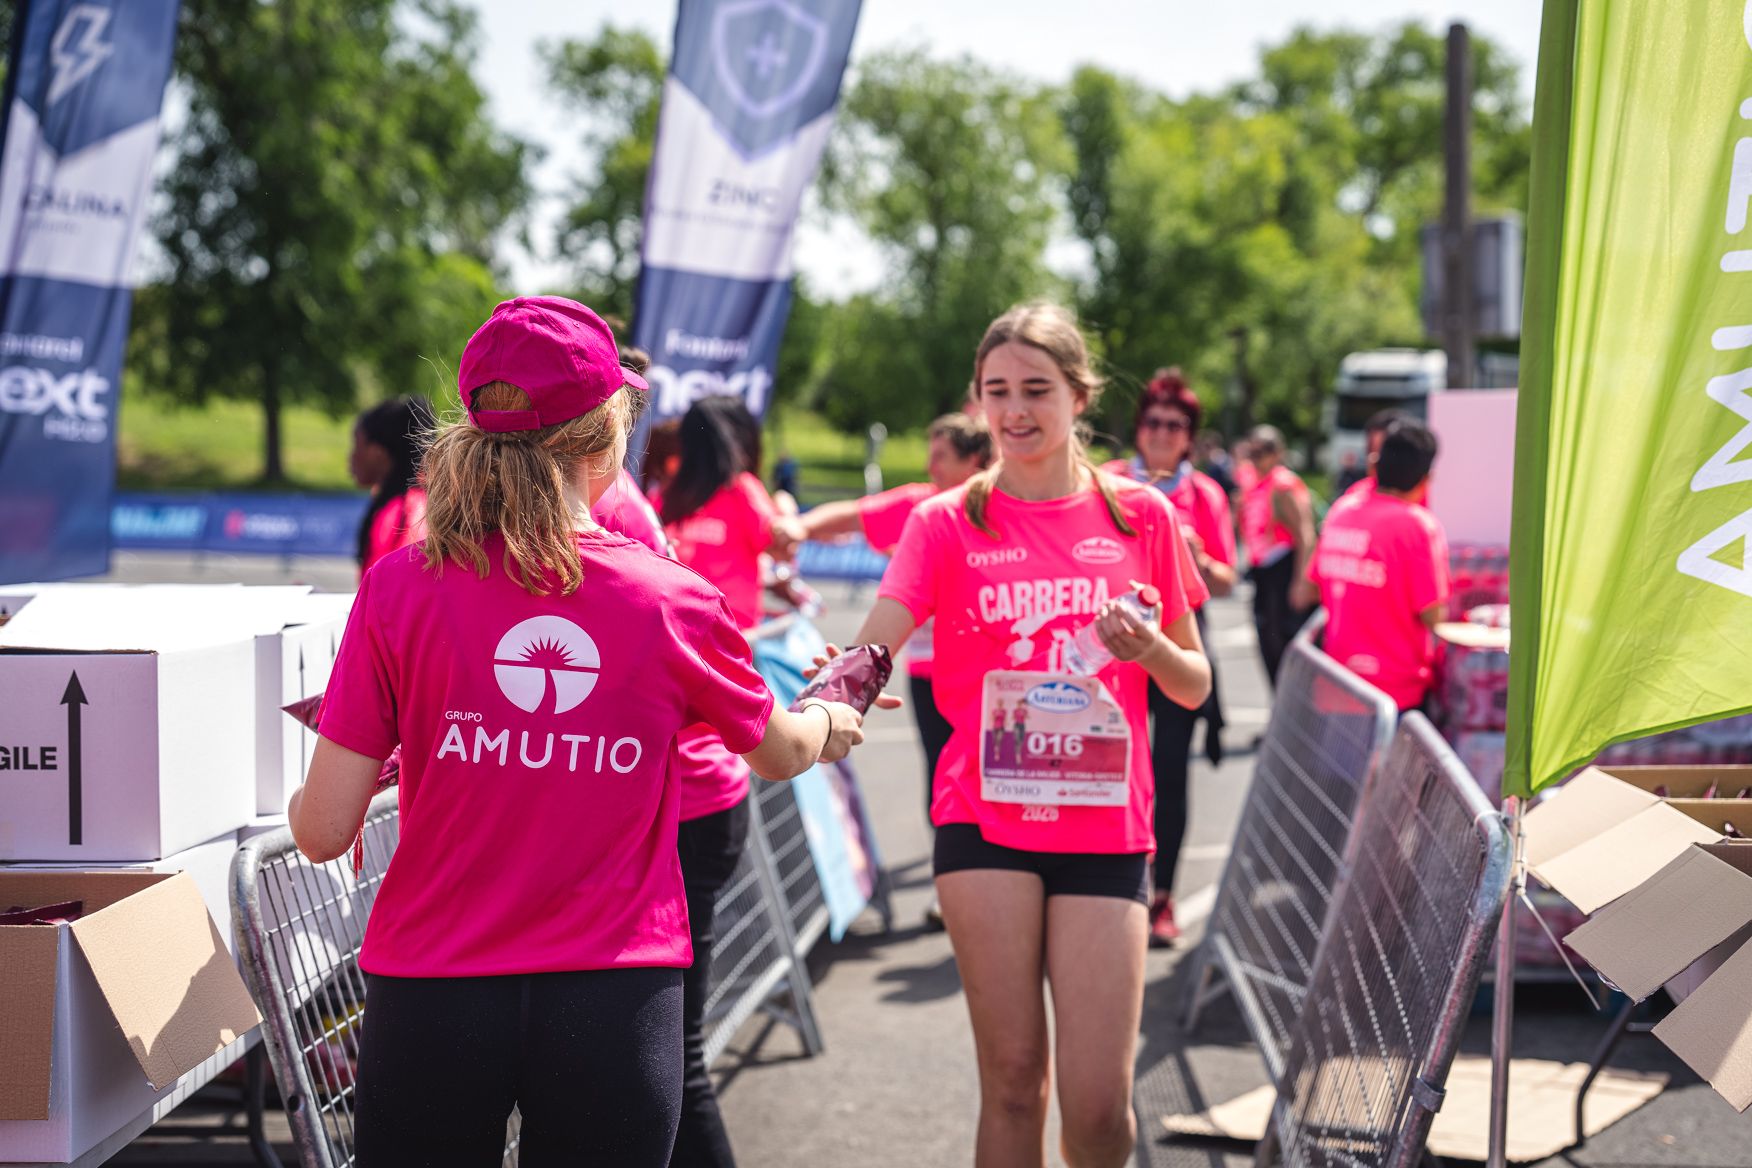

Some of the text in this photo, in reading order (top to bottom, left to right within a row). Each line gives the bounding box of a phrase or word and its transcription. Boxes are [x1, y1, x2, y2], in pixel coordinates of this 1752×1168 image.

[966, 547, 1028, 568] OYSHO
[445, 710, 482, 722] GRUPO
[436, 723, 643, 774] AMUTIO
[1027, 732, 1083, 757] 016
